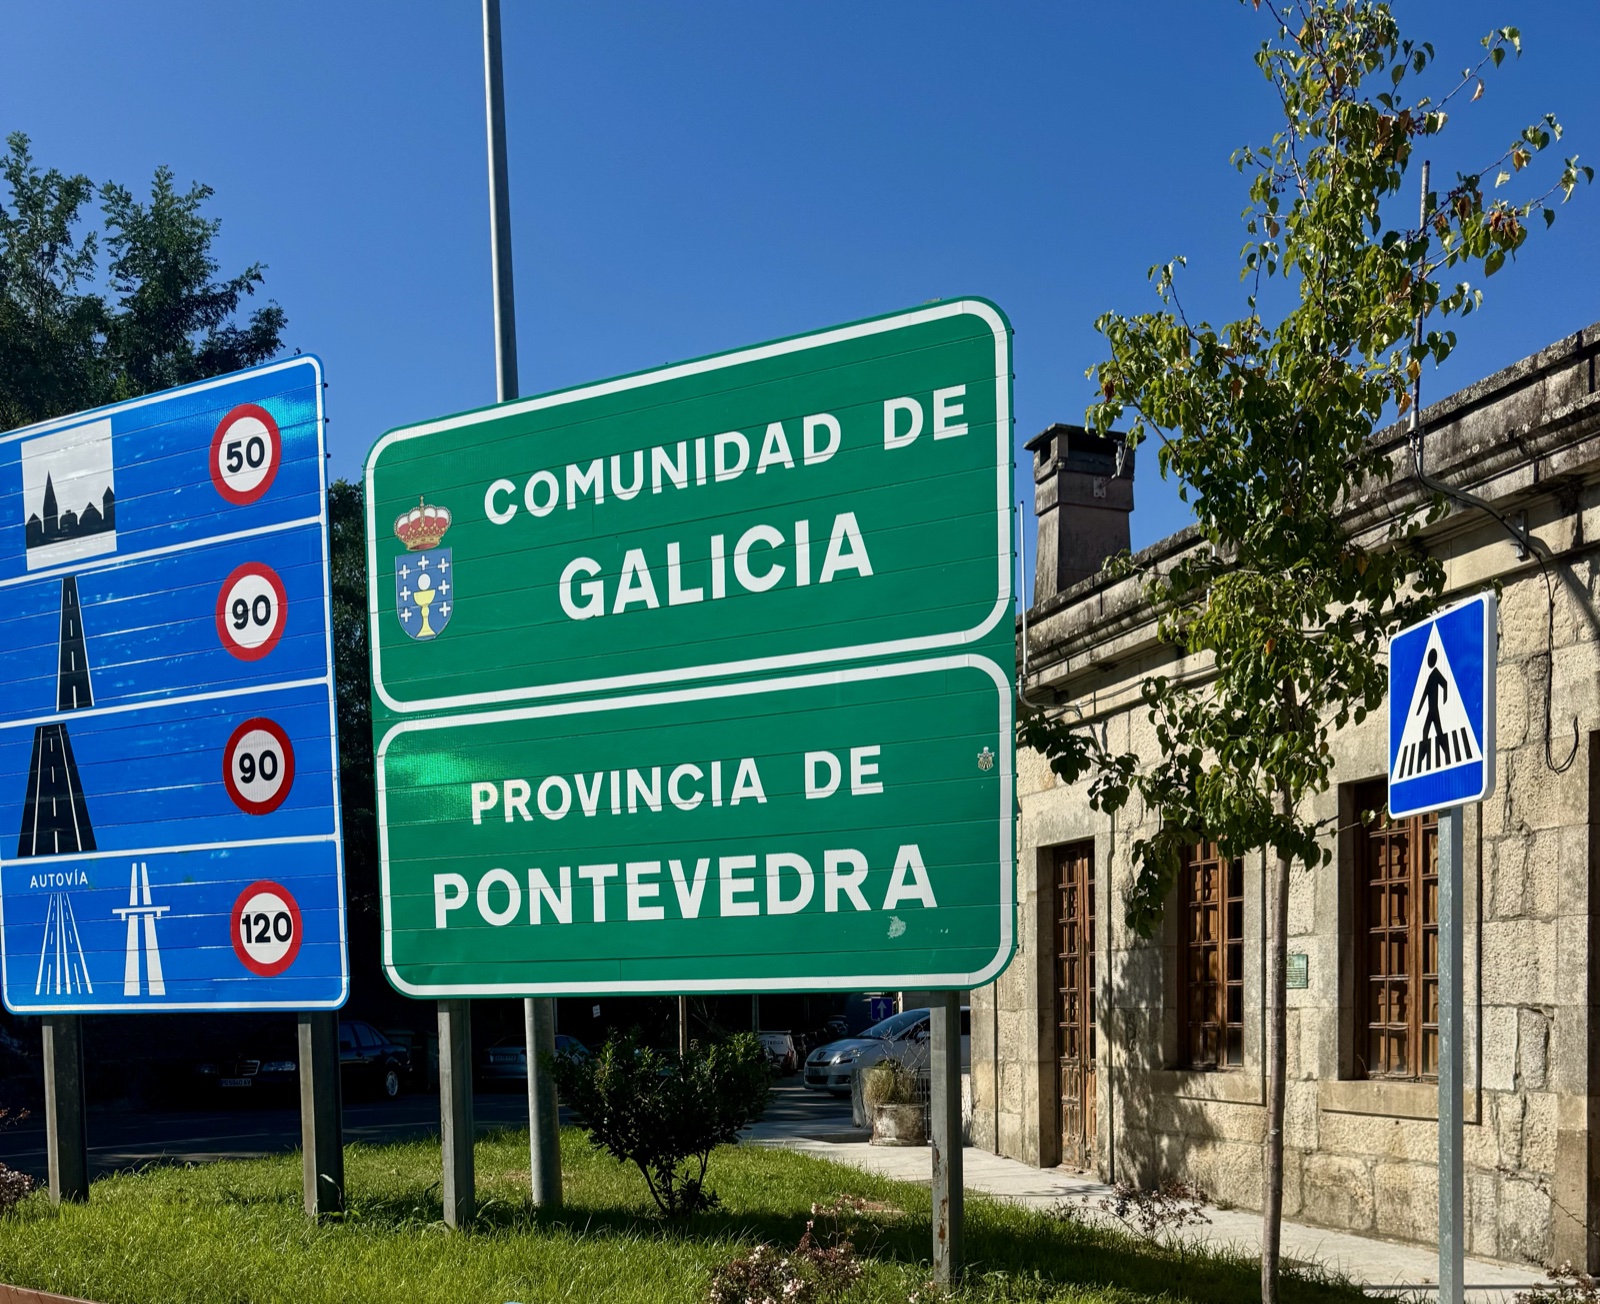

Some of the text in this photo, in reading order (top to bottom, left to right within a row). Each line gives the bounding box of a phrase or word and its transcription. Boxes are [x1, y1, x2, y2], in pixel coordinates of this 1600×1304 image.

[226, 436, 265, 473] 50
[484, 383, 969, 525] COMUNIDAD DE
[558, 511, 874, 622] GALICIA
[231, 594, 271, 630] 90
[238, 749, 278, 784] 90
[470, 744, 884, 826] PROVINCIA DE
[29, 868, 89, 889] AUTOVÍA
[433, 844, 938, 929] PONTEVEDRA
[241, 911, 293, 944] 120
